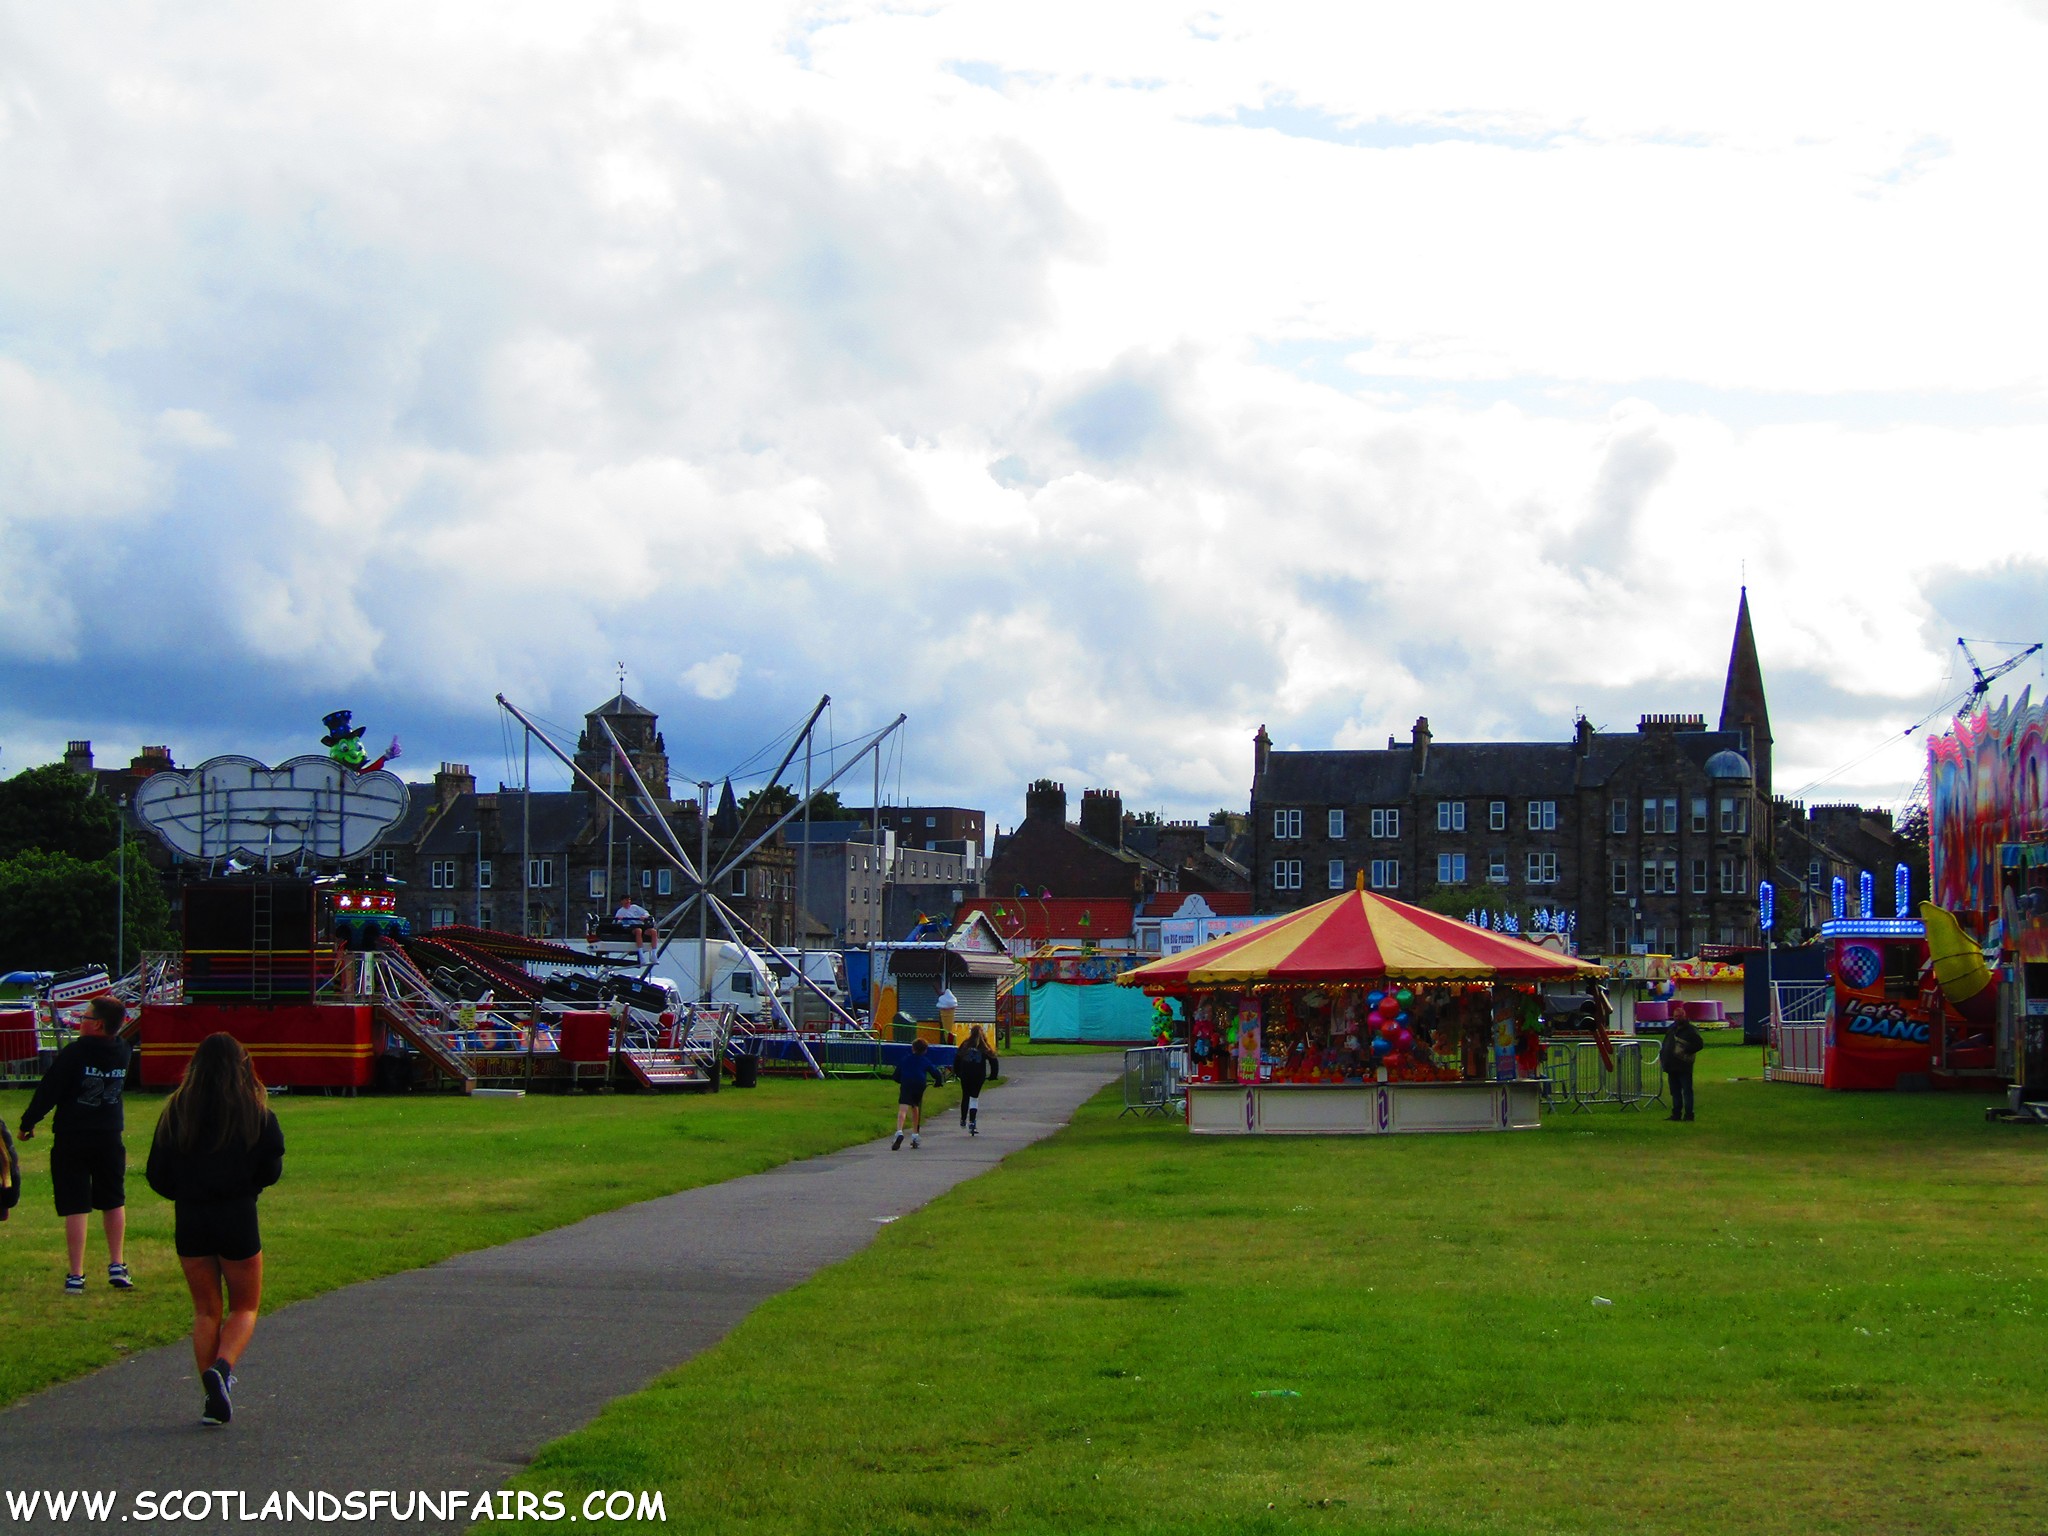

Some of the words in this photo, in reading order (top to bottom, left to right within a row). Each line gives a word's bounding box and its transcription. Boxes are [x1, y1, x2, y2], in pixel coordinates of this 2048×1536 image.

[1178, 935, 1193, 943] PRIZES
[1845, 1000, 1903, 1019] Let's
[1849, 1015, 1930, 1041] DANC
